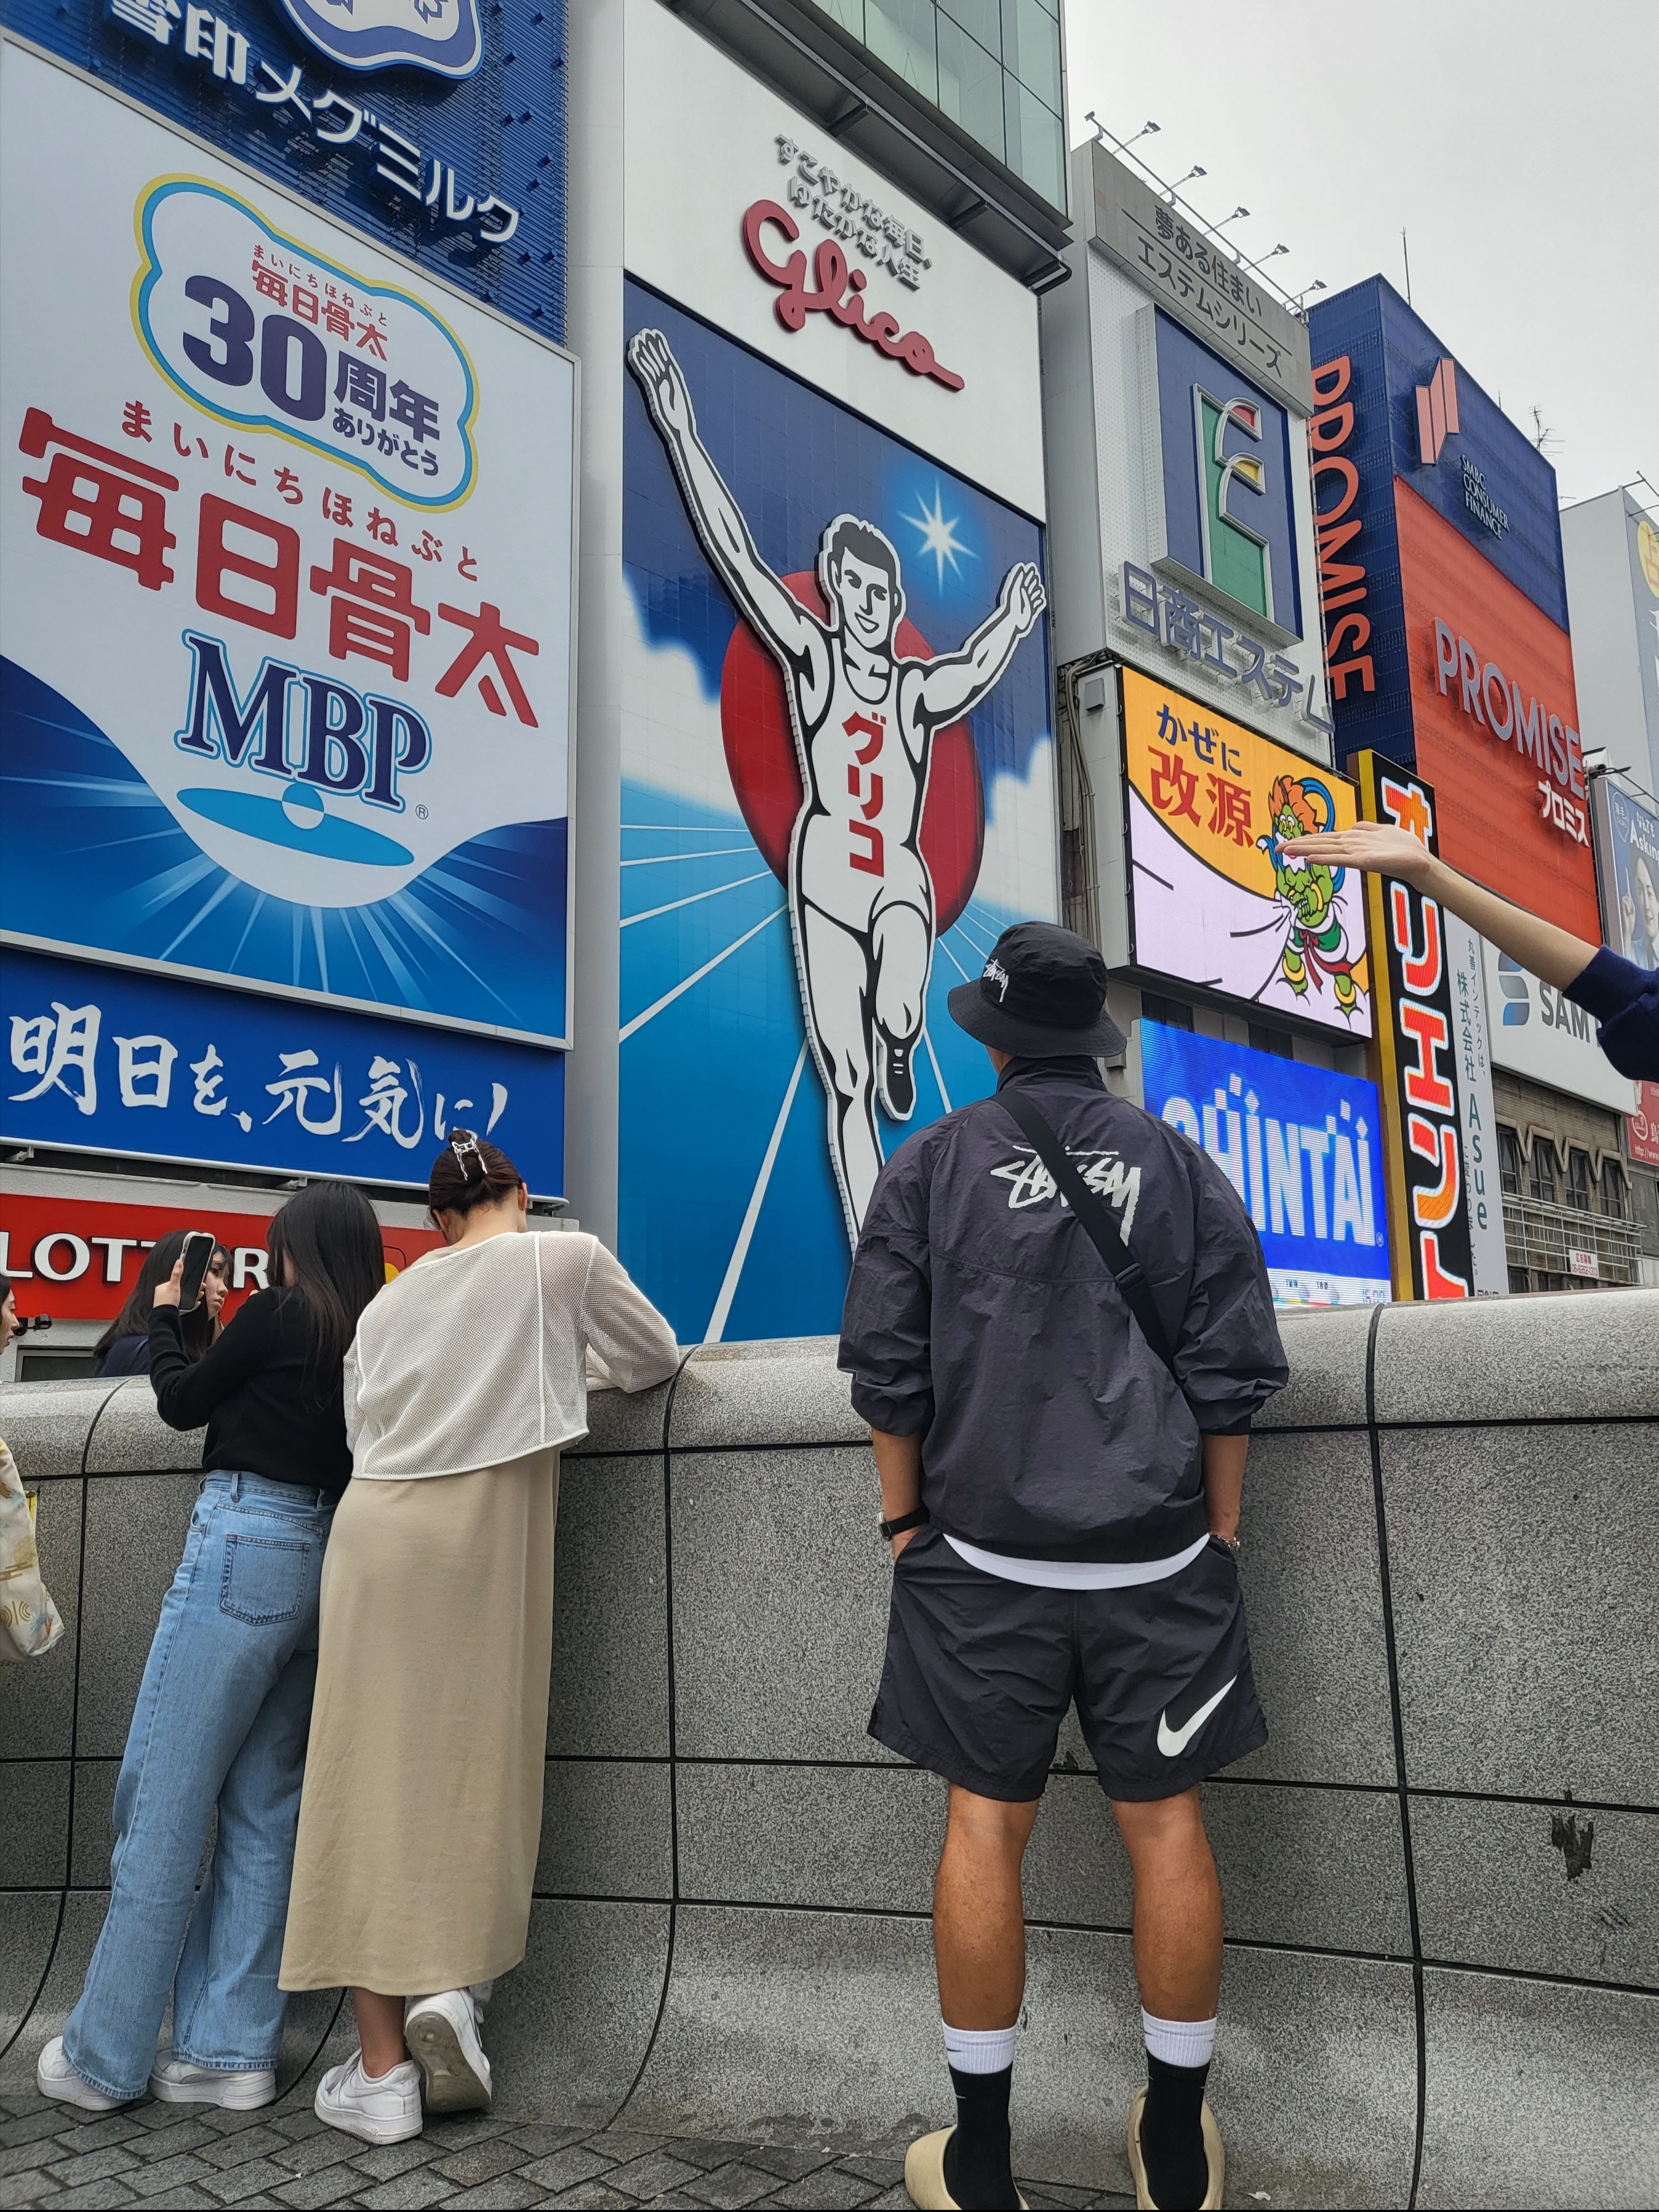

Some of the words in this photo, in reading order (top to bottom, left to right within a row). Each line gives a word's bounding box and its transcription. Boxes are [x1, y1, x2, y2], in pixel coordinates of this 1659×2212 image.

[111, 0, 519, 244] 雪印メグミルク
[775, 134, 933, 269] すこやかな毎日、
[787, 176, 921, 291] ゆたかな人生
[1154, 204, 1262, 317] 夢ある住まい
[252, 259, 388, 362] 毎日骨太
[253, 244, 388, 327] まいにちほねぶと
[743, 199, 965, 391] Glico
[1138, 235, 1282, 378] エステムシリーズ
[182, 275, 440, 444] 30周年
[122, 400, 479, 582] まいにちほねぶと
[332, 406, 439, 476] ありがとう
[1462, 454, 1486, 491] SMBC
[1463, 473, 1511, 533] CONSUMER
[19, 406, 540, 728] 毎日骨太
[1465, 491, 1503, 540] FINANCE
[1119, 560, 1336, 734] 日商エステム
[1434, 617, 1585, 800] PROMISE
[177, 632, 429, 810] MBP
[1156, 703, 1242, 777] かぜに
[841, 711, 886, 878] グリコ
[1147, 745, 1254, 848] 改源
[1537, 780, 1590, 848] プロミス
[1457, 969, 1477, 1082] 株式会社
[1469, 1093, 1488, 1230] Asue
